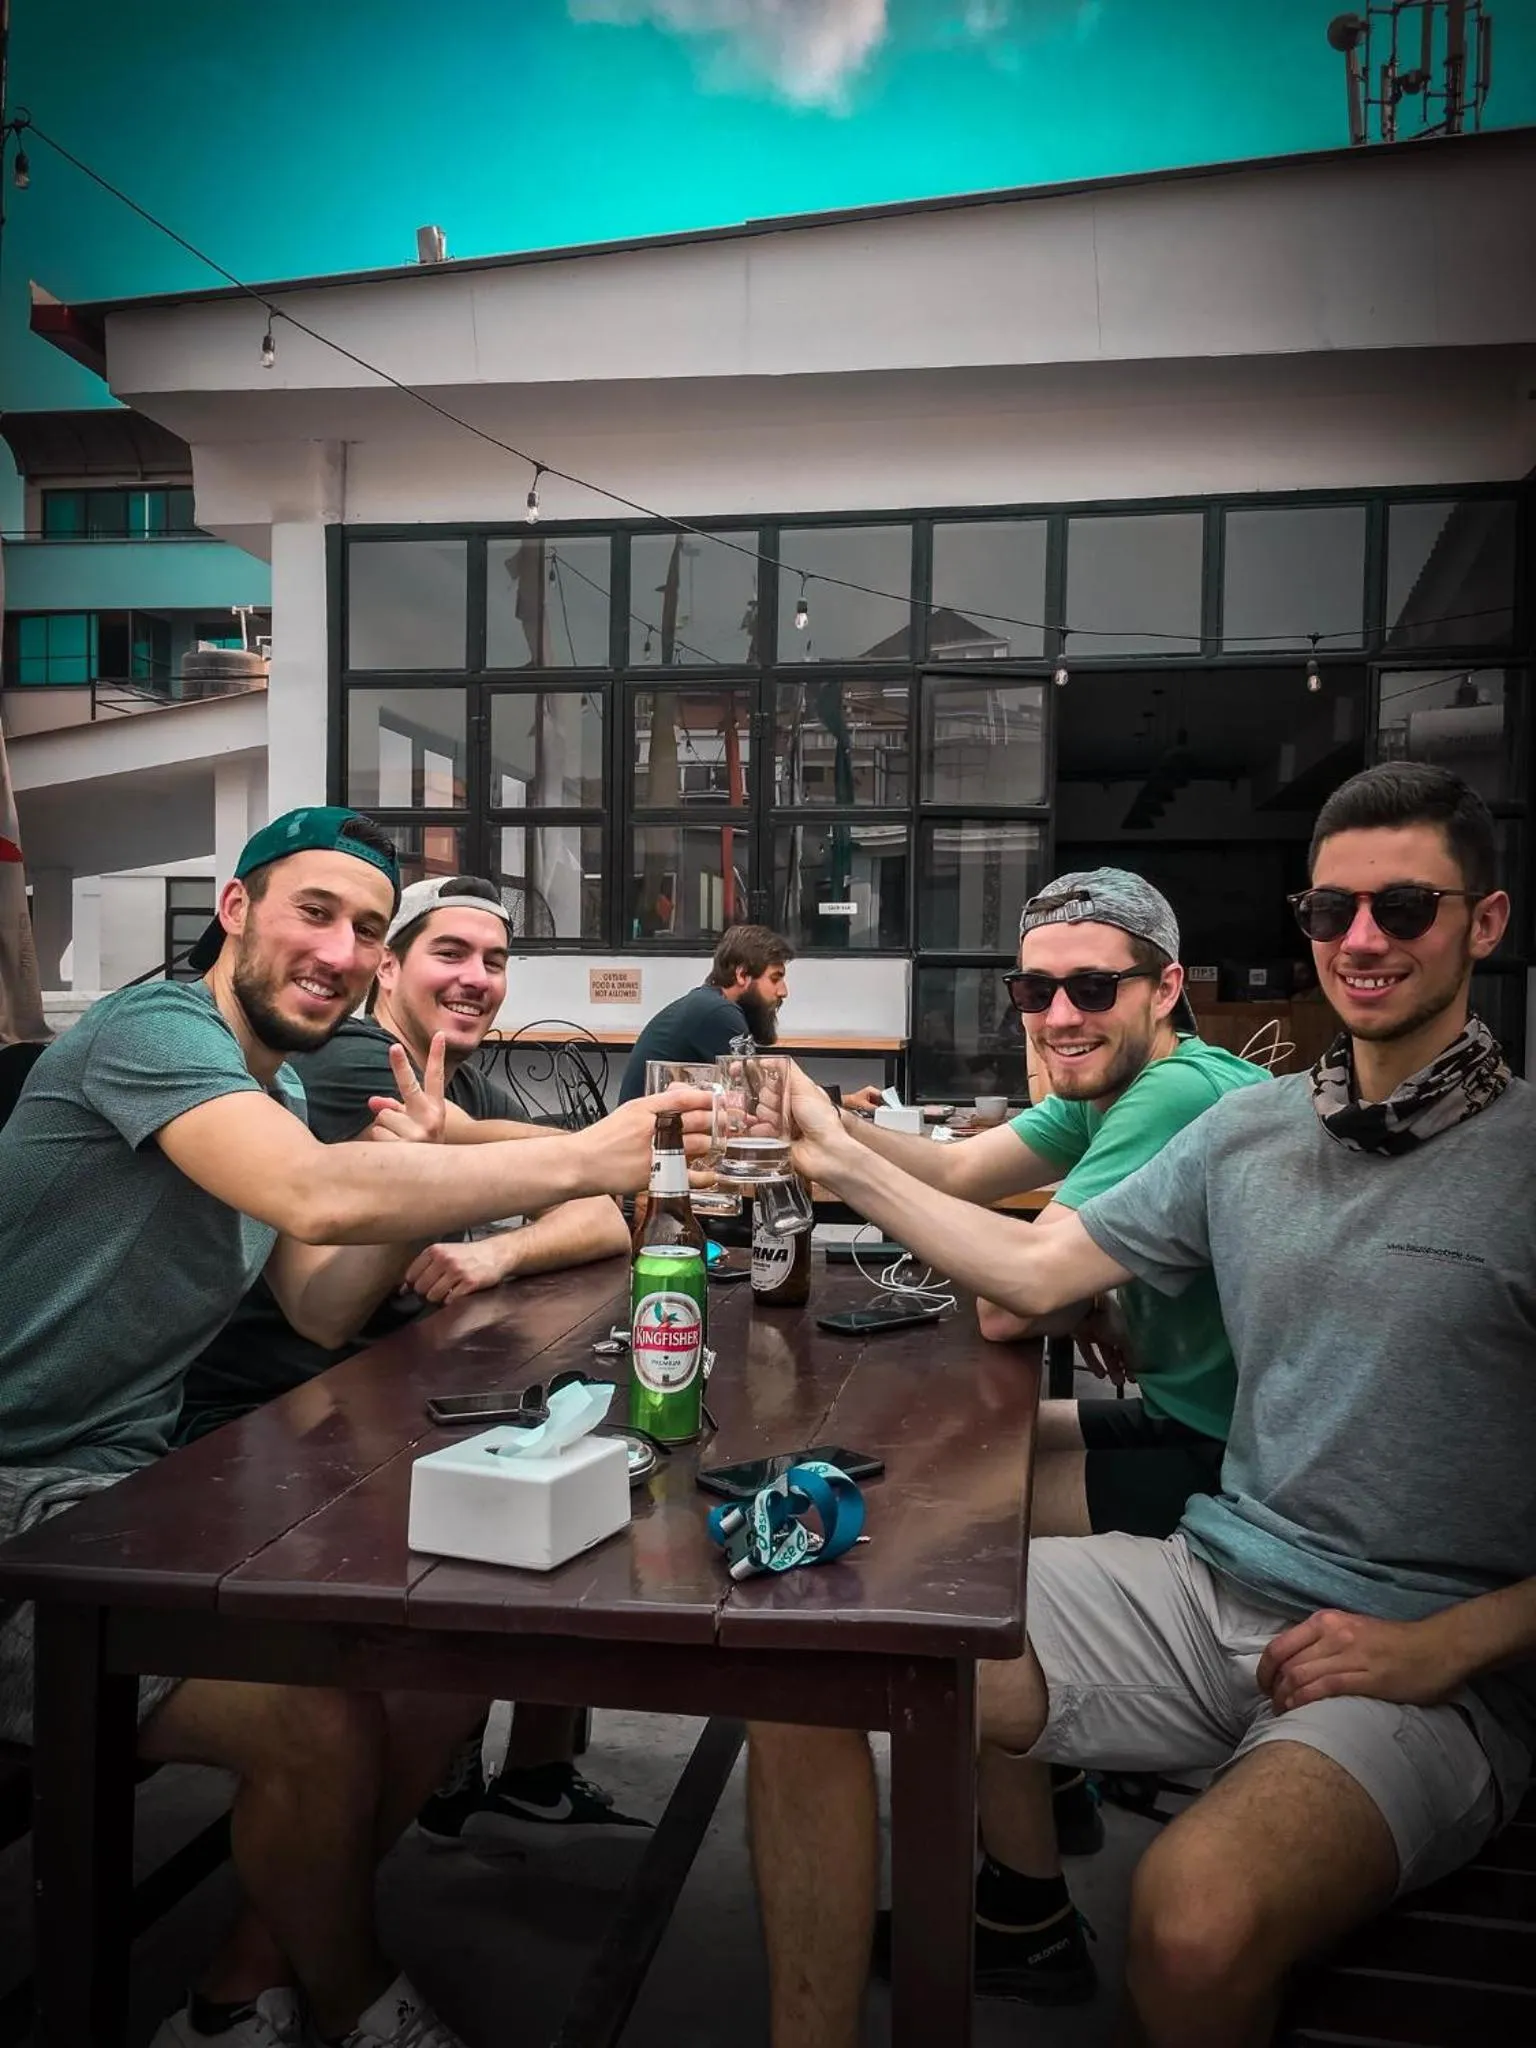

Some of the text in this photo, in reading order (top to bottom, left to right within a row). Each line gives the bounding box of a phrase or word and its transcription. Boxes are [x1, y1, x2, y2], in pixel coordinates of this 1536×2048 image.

[592, 981, 611, 989] FOOD
[753, 1246, 789, 1262] RNA
[636, 1327, 699, 1347] KINGFISHER
